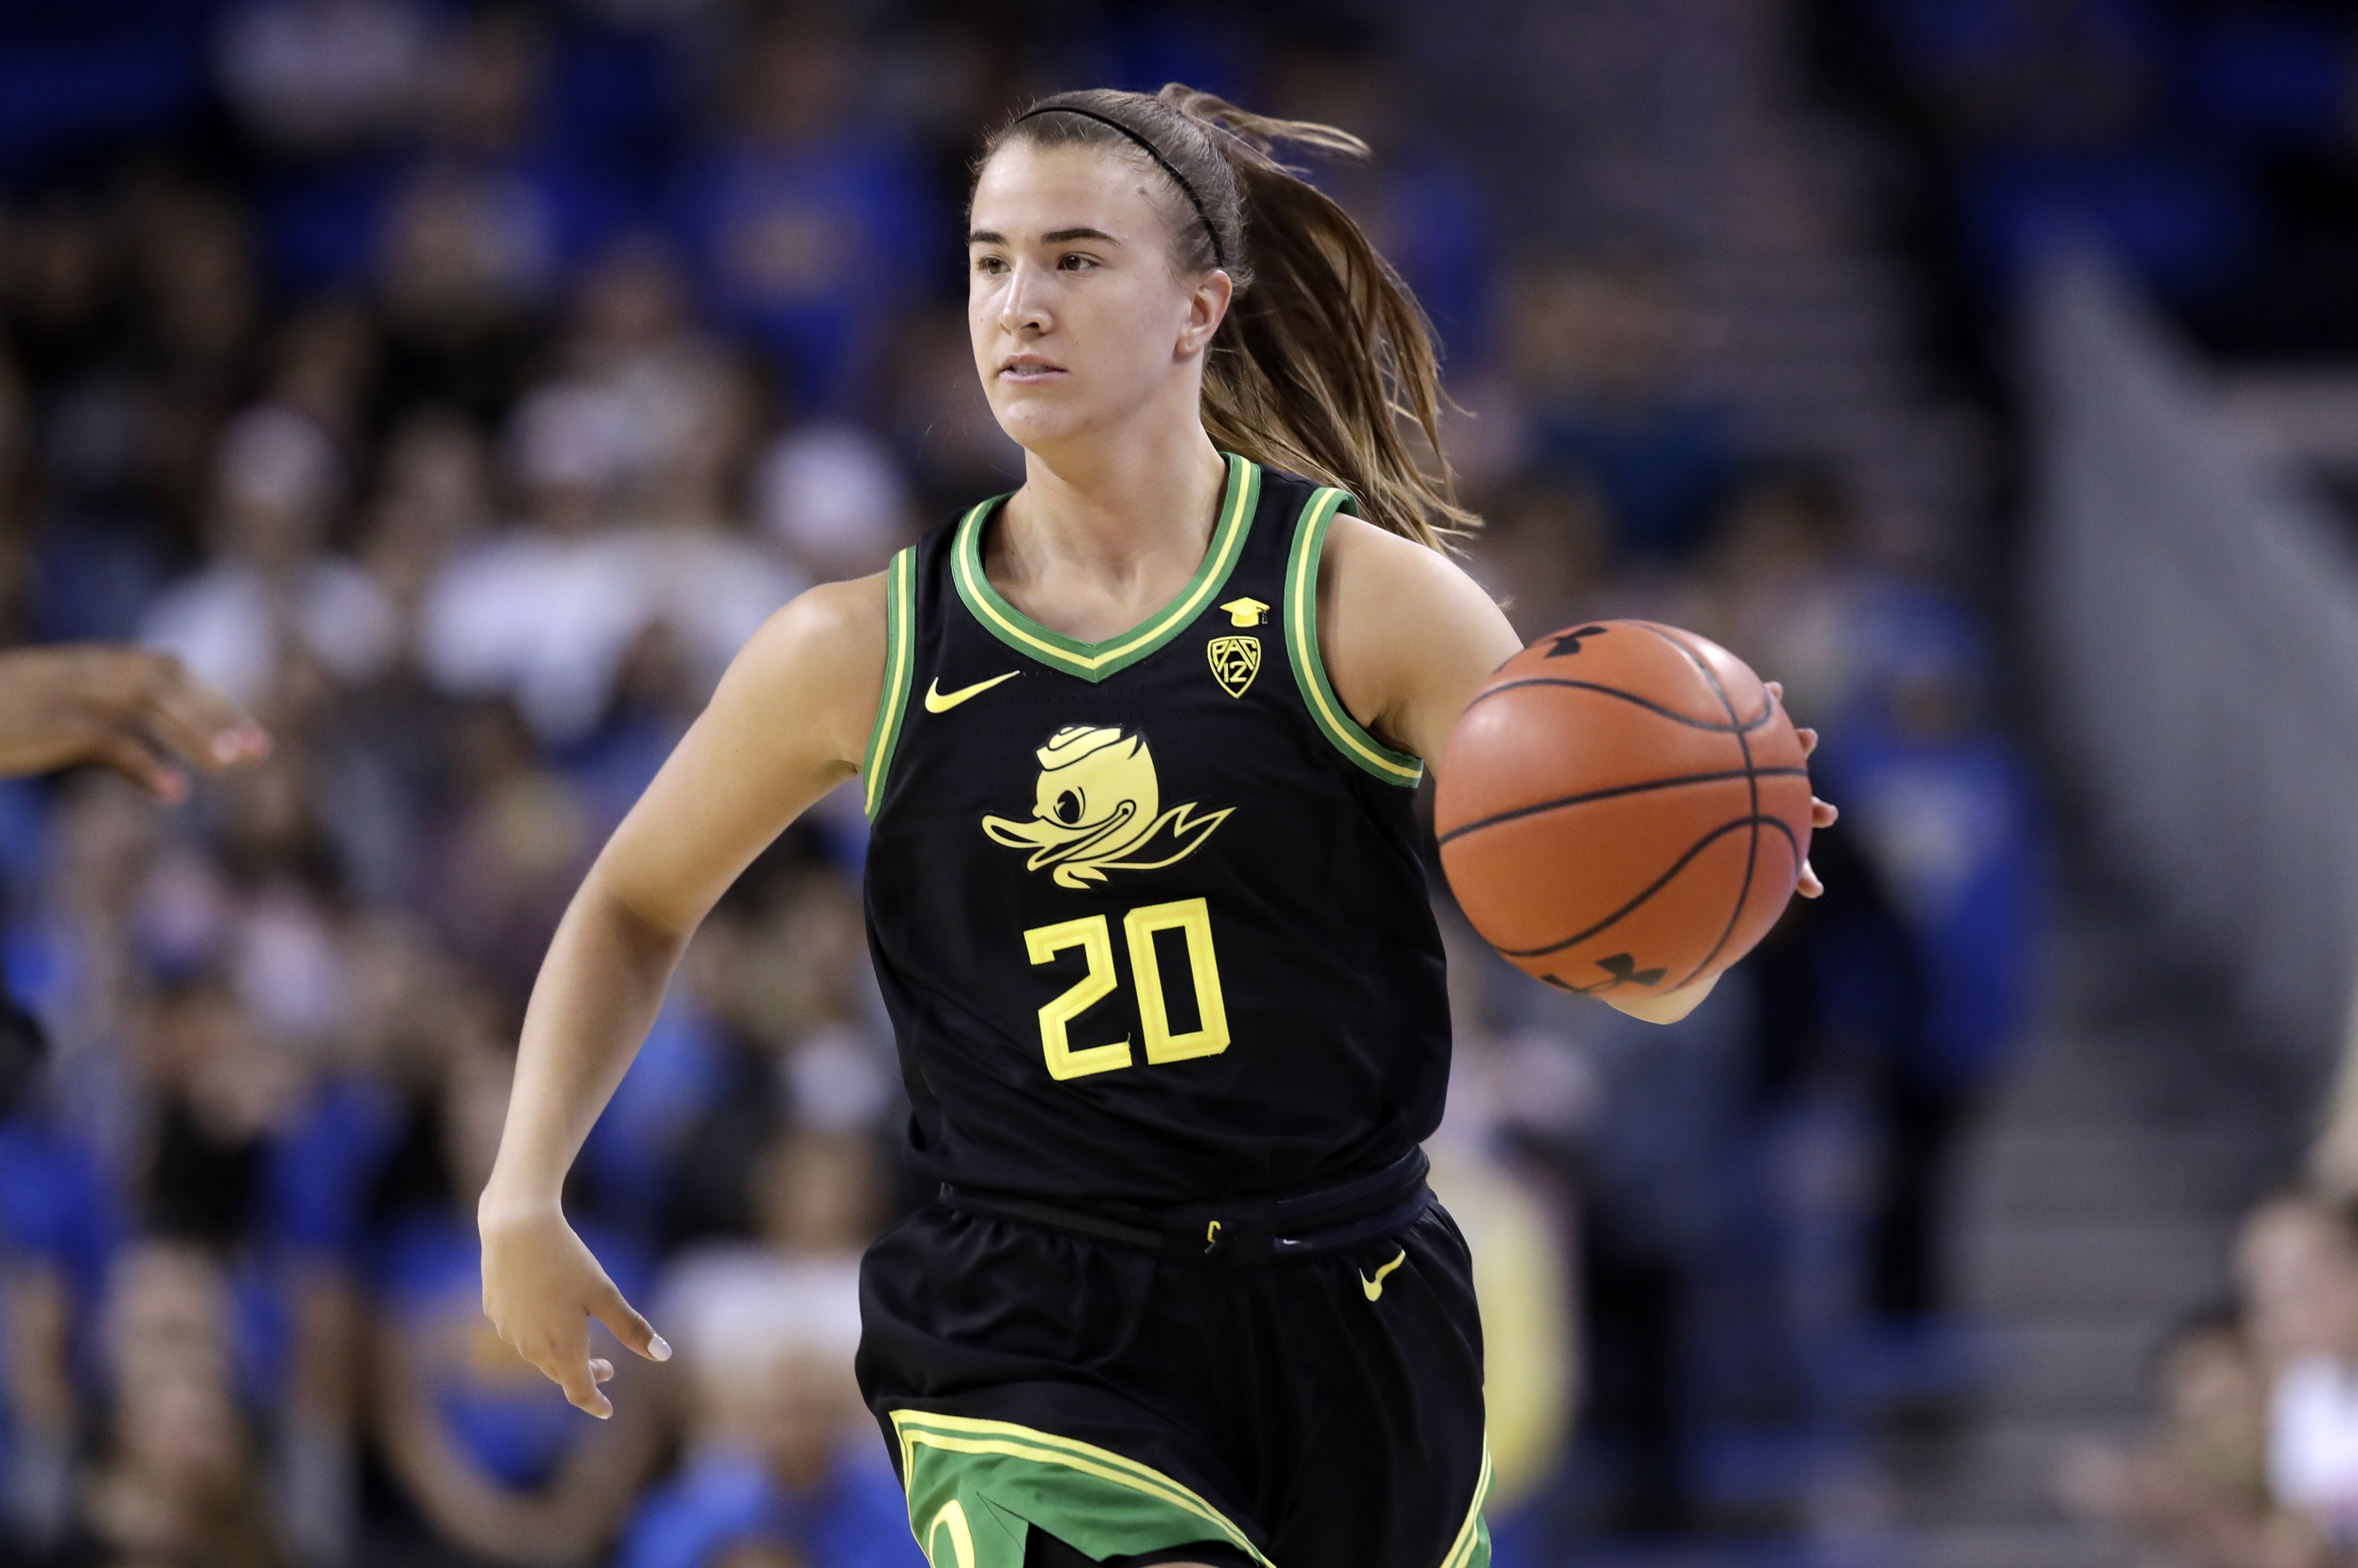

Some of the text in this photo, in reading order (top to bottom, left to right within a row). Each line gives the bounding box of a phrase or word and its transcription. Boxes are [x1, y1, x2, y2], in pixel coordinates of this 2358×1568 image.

[1212, 639, 1257, 673] PAC
[1223, 660, 1247, 683] 12
[1023, 897, 1231, 1081] 20
